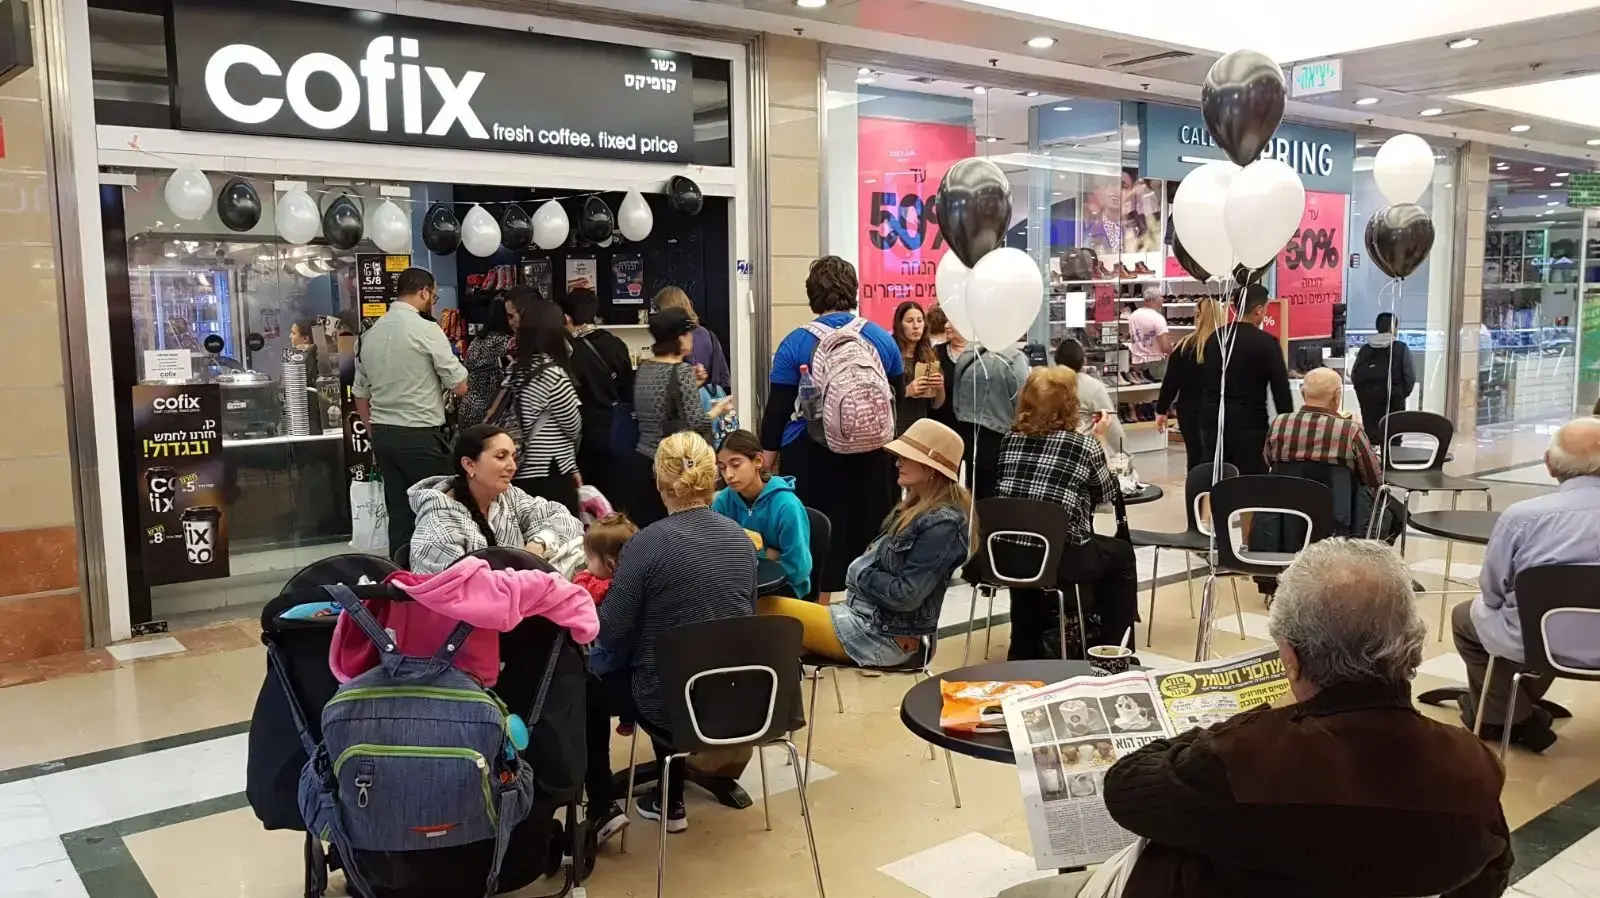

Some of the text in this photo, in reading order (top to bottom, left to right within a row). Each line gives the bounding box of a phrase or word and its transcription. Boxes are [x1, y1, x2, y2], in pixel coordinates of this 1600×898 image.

[651, 58, 677, 72] כשר
[205, 36, 490, 139] cofix
[624, 74, 677, 93] קופיקס
[493, 123, 678, 154] fresh coffee. fixed price
[1260, 138, 1333, 176] PRING
[910, 168, 926, 183] עד
[1308, 209, 1319, 220] עד
[1285, 227, 1340, 270] 50%
[901, 261, 937, 276] הנחה
[915, 283, 937, 298] מים
[153, 394, 200, 410] cofix
[202, 420, 216, 429] כן,
[154, 430, 216, 442] חזרנו לחמש
[143, 440, 209, 458] ובגדול!
[1243, 658, 1286, 680] מחסני
[1195, 668, 1242, 687] חשמל
[1240, 687, 1268, 699] אחרונים
[1115, 737, 1136, 749] הוא
